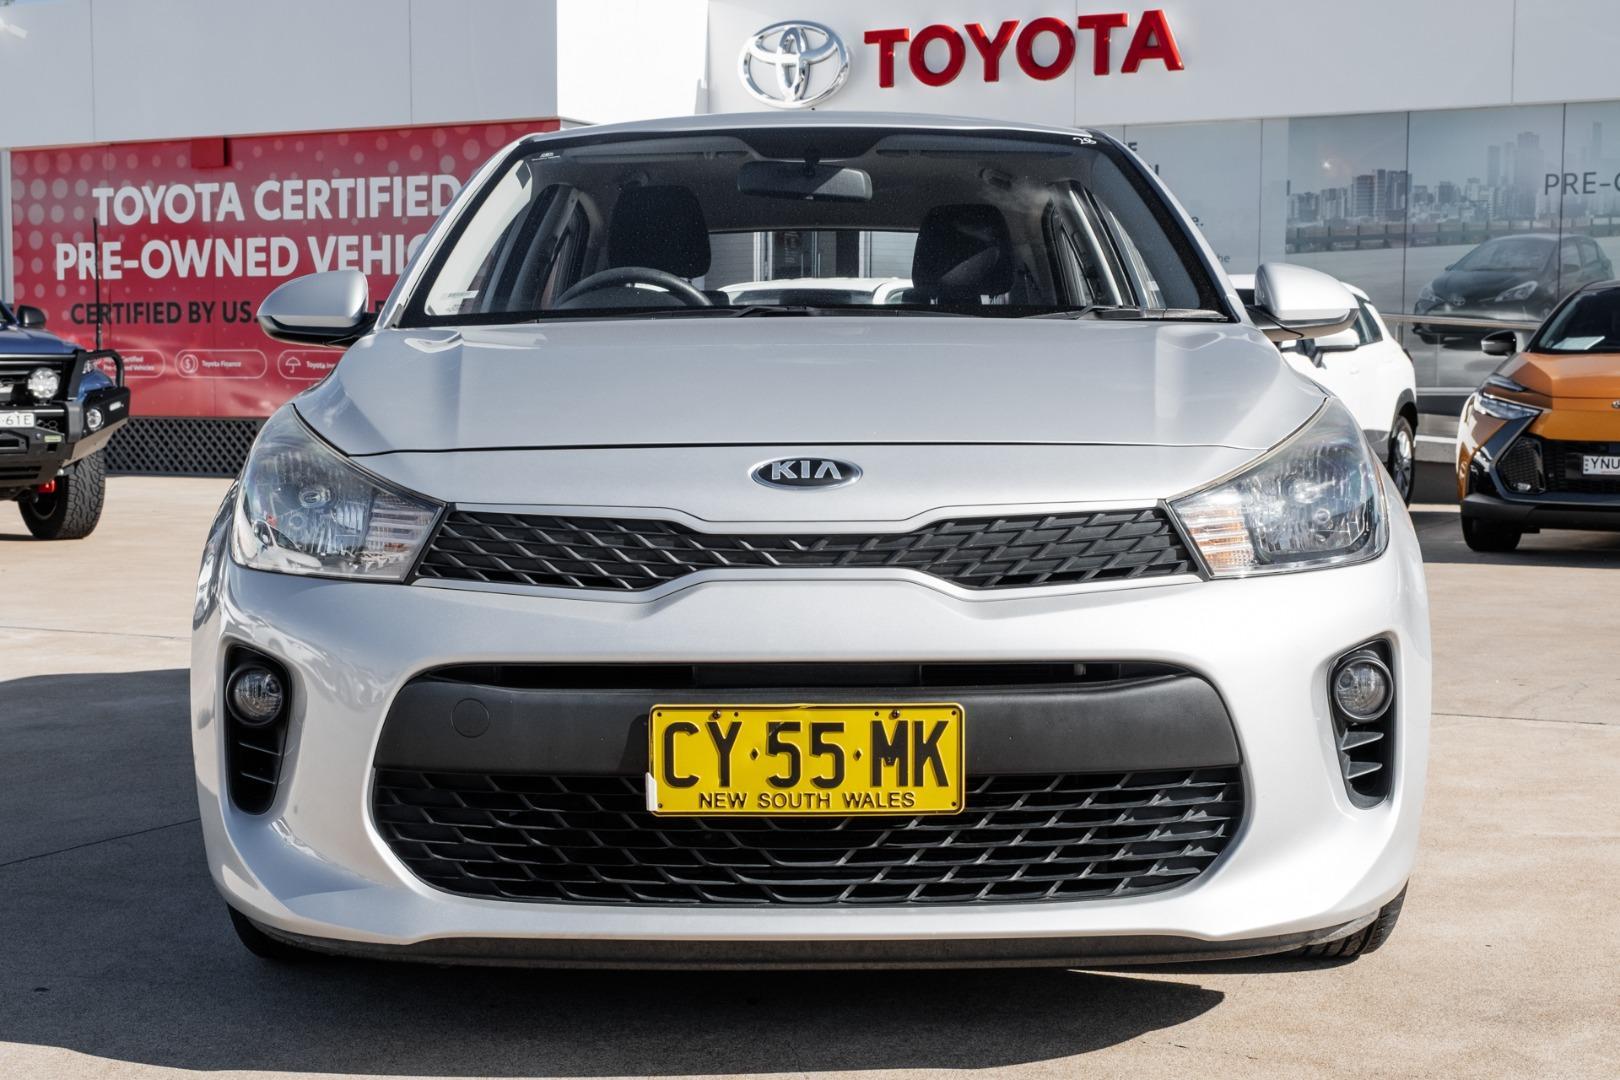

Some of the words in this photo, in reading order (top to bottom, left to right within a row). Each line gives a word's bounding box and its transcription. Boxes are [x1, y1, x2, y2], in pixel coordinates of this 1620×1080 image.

[864, 10, 1184, 88] TOYOTA
[93, 182, 245, 227] TOYOTA
[254, 174, 461, 220] CERTIFIED
[56, 237, 299, 281] PRE-OWNED
[70, 302, 183, 325] CERTIFIED
[188, 301, 216, 323] BY
[201, 359, 220, 369] Toyota
[306, 361, 326, 370] Toyota
[771, 460, 842, 480] KIA
[699, 792, 747, 808] NEW
[757, 791, 832, 808] SOUTH
[842, 791, 915, 808] WALES
